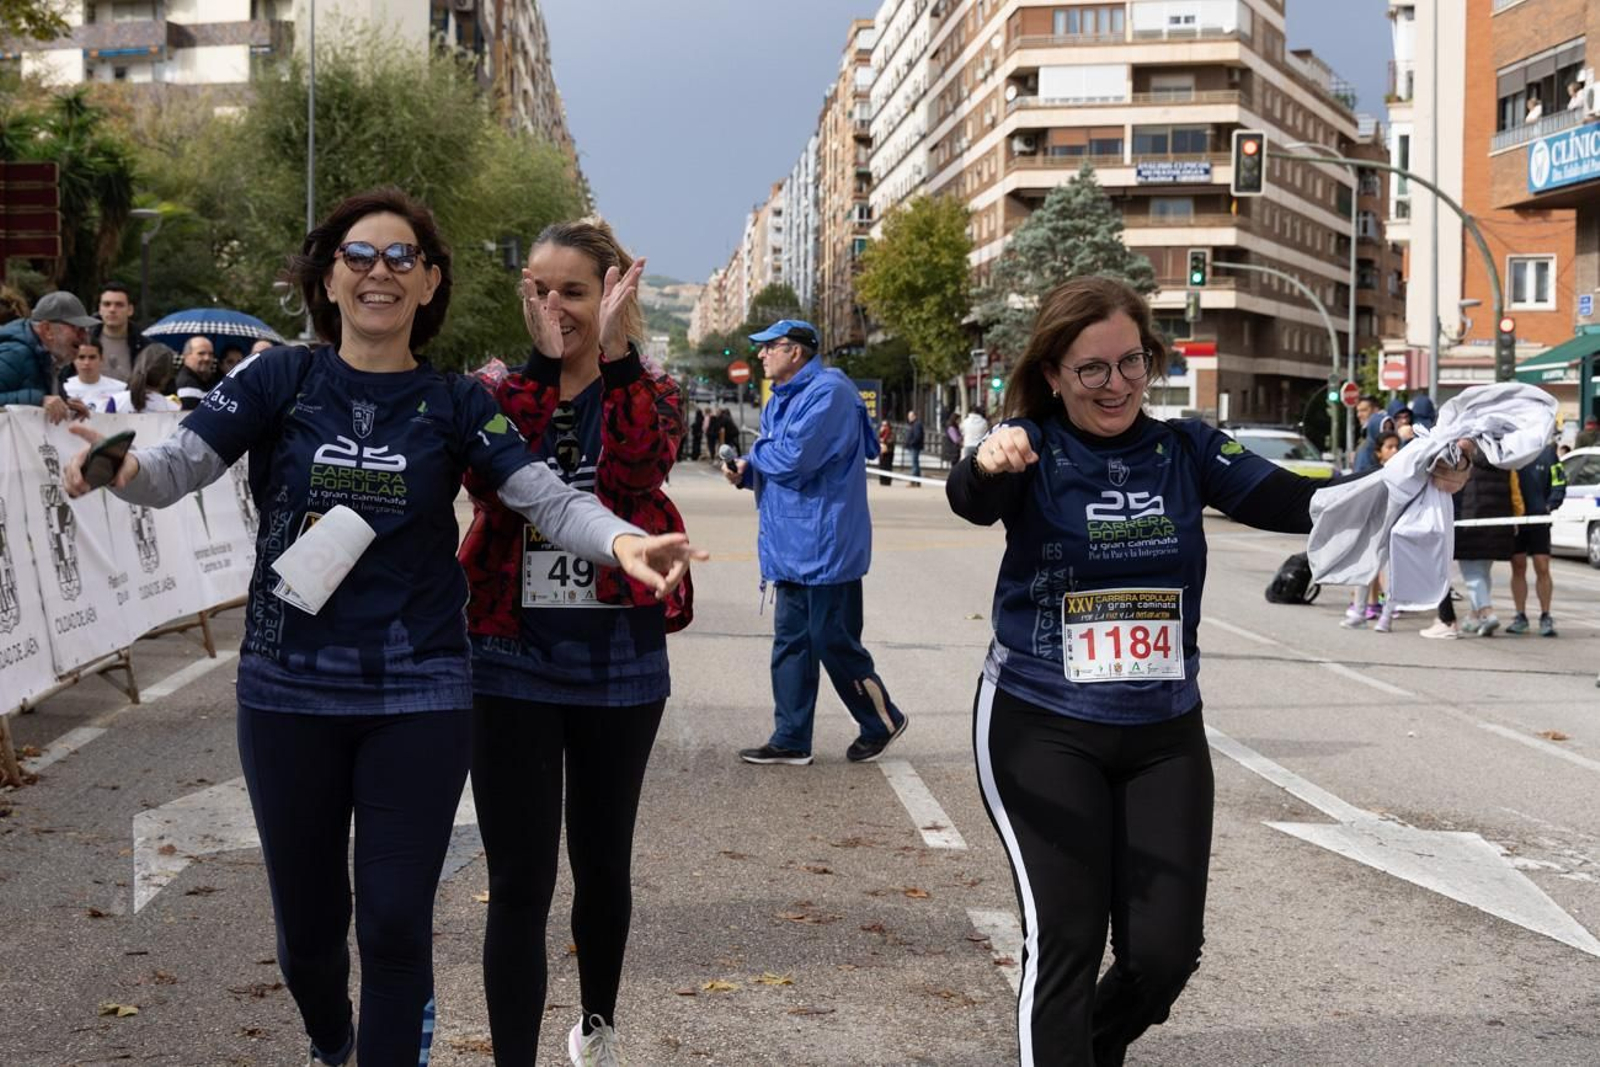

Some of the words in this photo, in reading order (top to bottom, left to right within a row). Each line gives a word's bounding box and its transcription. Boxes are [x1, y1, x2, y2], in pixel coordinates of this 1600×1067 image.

[313, 435, 407, 472] 25
[311, 464, 405, 485] CARRERA
[310, 476, 407, 497] POPULAR
[309, 489, 318, 498] y
[320, 490, 348, 500] gran
[351, 493, 407, 506] caminata
[1085, 490, 1165, 521] 25
[1087, 516, 1172, 531] CARRERA
[1089, 524, 1175, 541] POPULAR
[1089, 543, 1098, 551] y
[1100, 541, 1125, 551] gran
[1127, 536, 1178, 548] caminata
[548, 555, 595, 588] 49
[1067, 597, 1094, 613] XXV
[1095, 593, 1138, 603] CARRERA
[1139, 593, 1177, 602] POPULAR
[1107, 602, 1133, 611] gran
[1078, 625, 1171, 661] 1184
